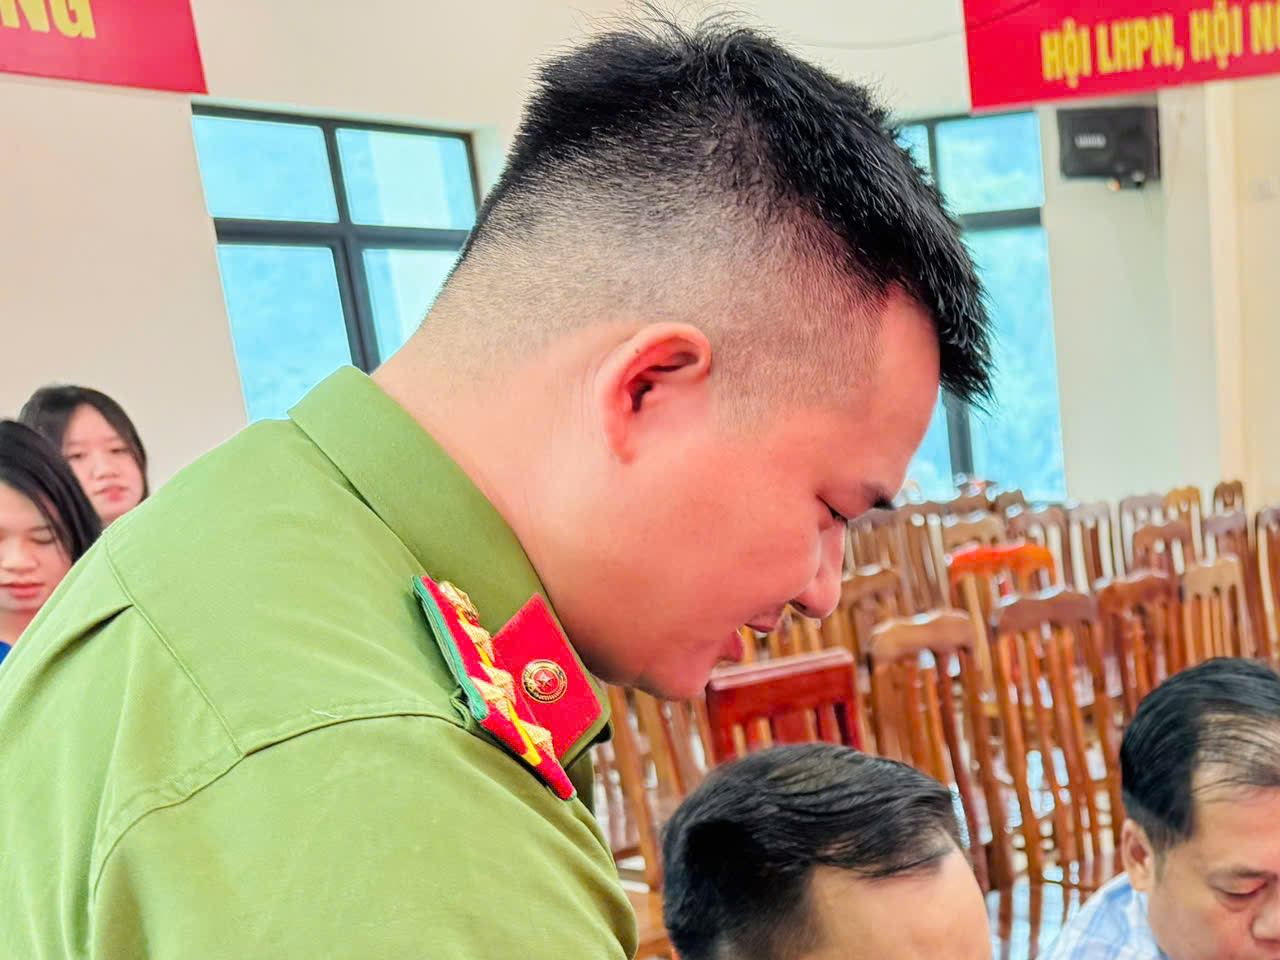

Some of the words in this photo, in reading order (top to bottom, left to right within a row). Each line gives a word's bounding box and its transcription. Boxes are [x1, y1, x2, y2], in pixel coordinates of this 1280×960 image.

[1041, 16, 1092, 88] HỘI
[1096, 14, 1184, 71] LHPN,
[1190, 0, 1242, 70] HỘI
